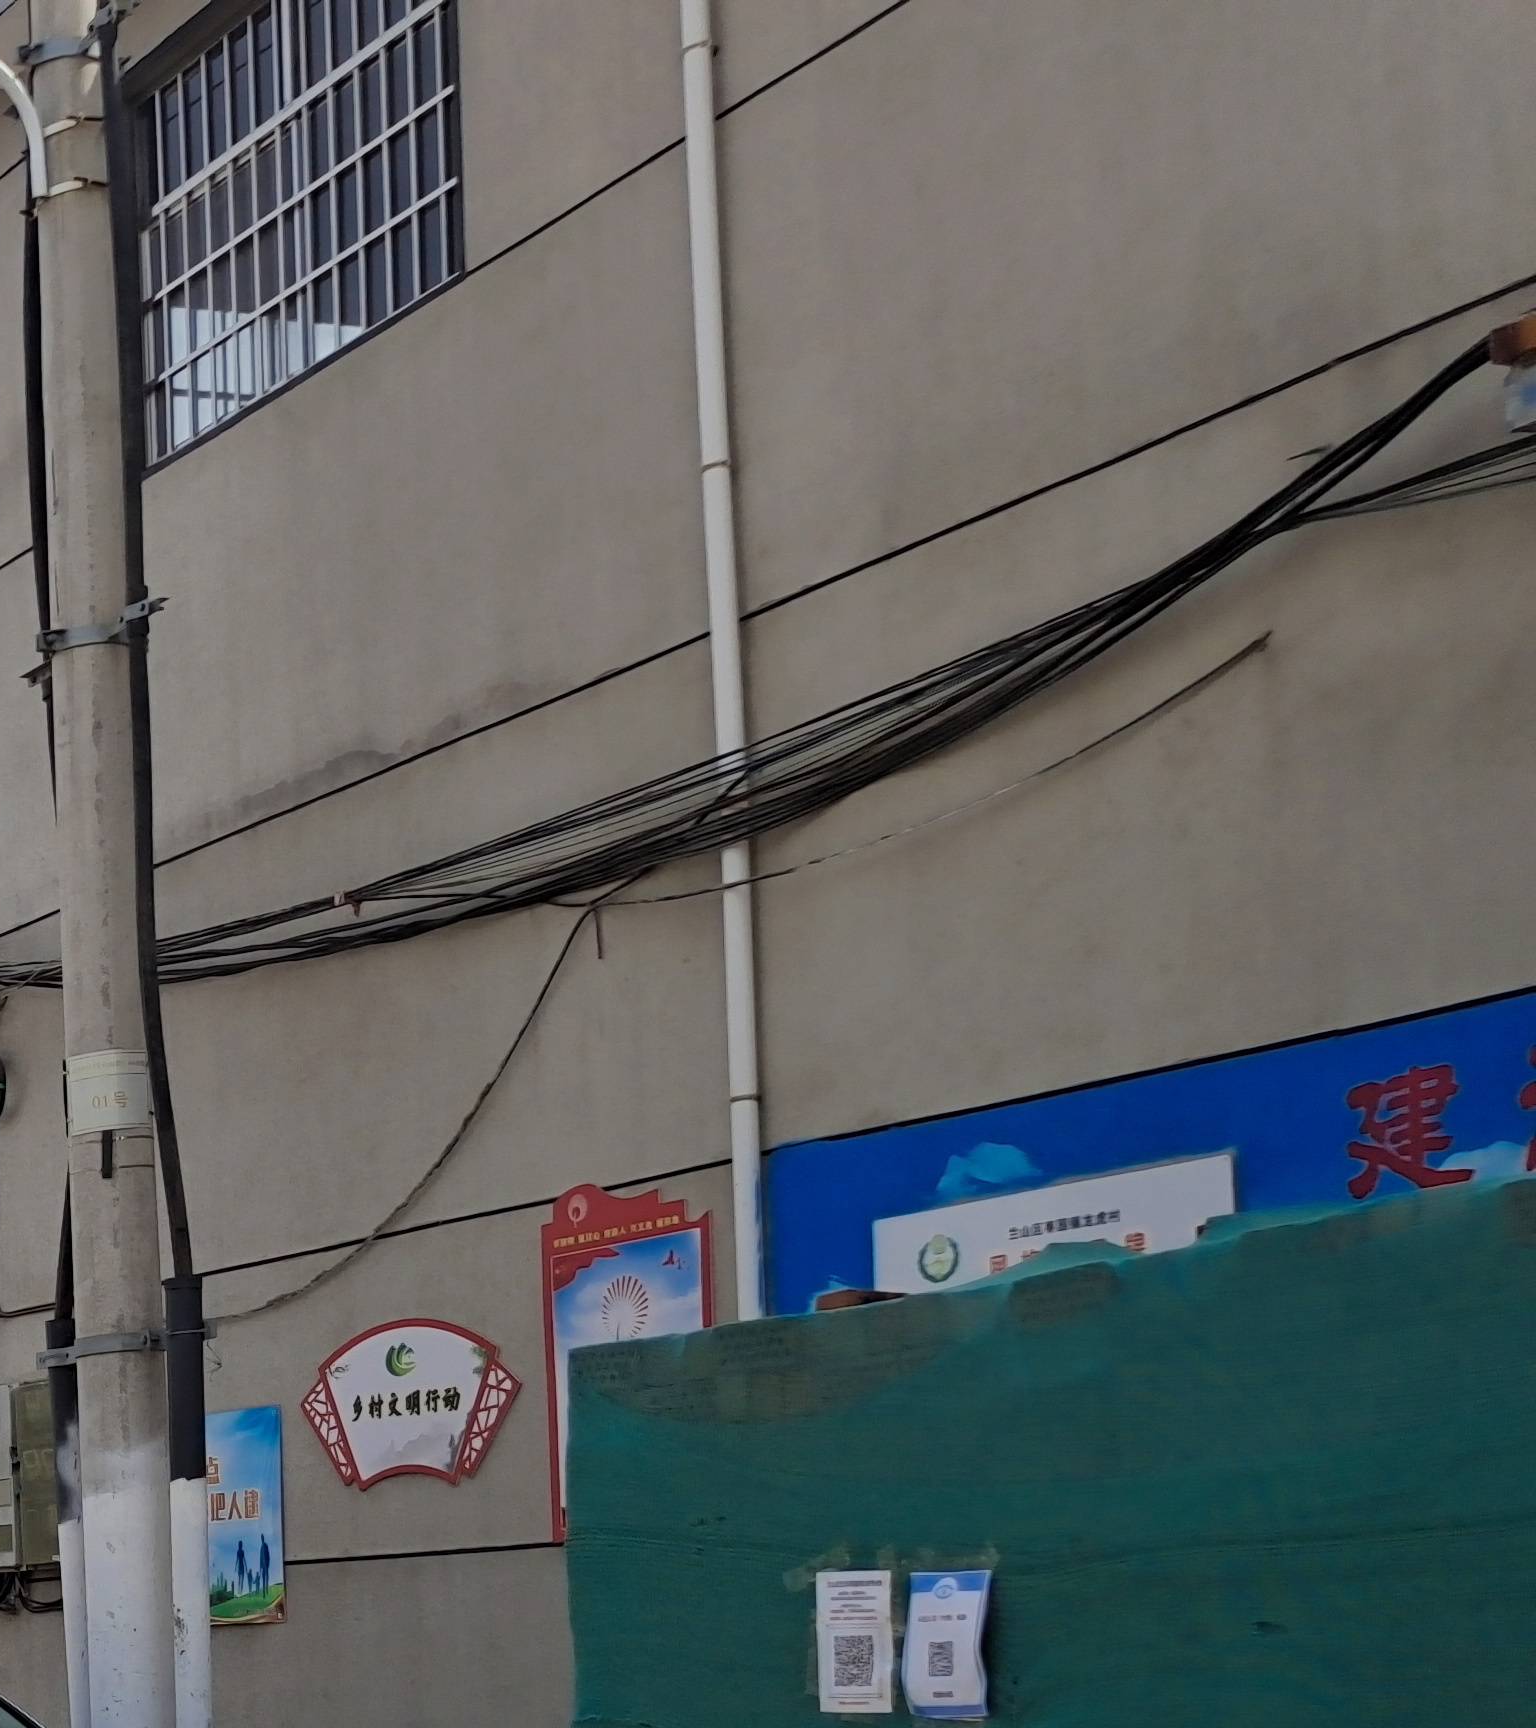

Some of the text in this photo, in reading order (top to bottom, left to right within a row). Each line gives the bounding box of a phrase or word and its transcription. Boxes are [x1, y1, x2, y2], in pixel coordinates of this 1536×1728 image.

[351, 1386, 462, 1423] 乡村文明行动
